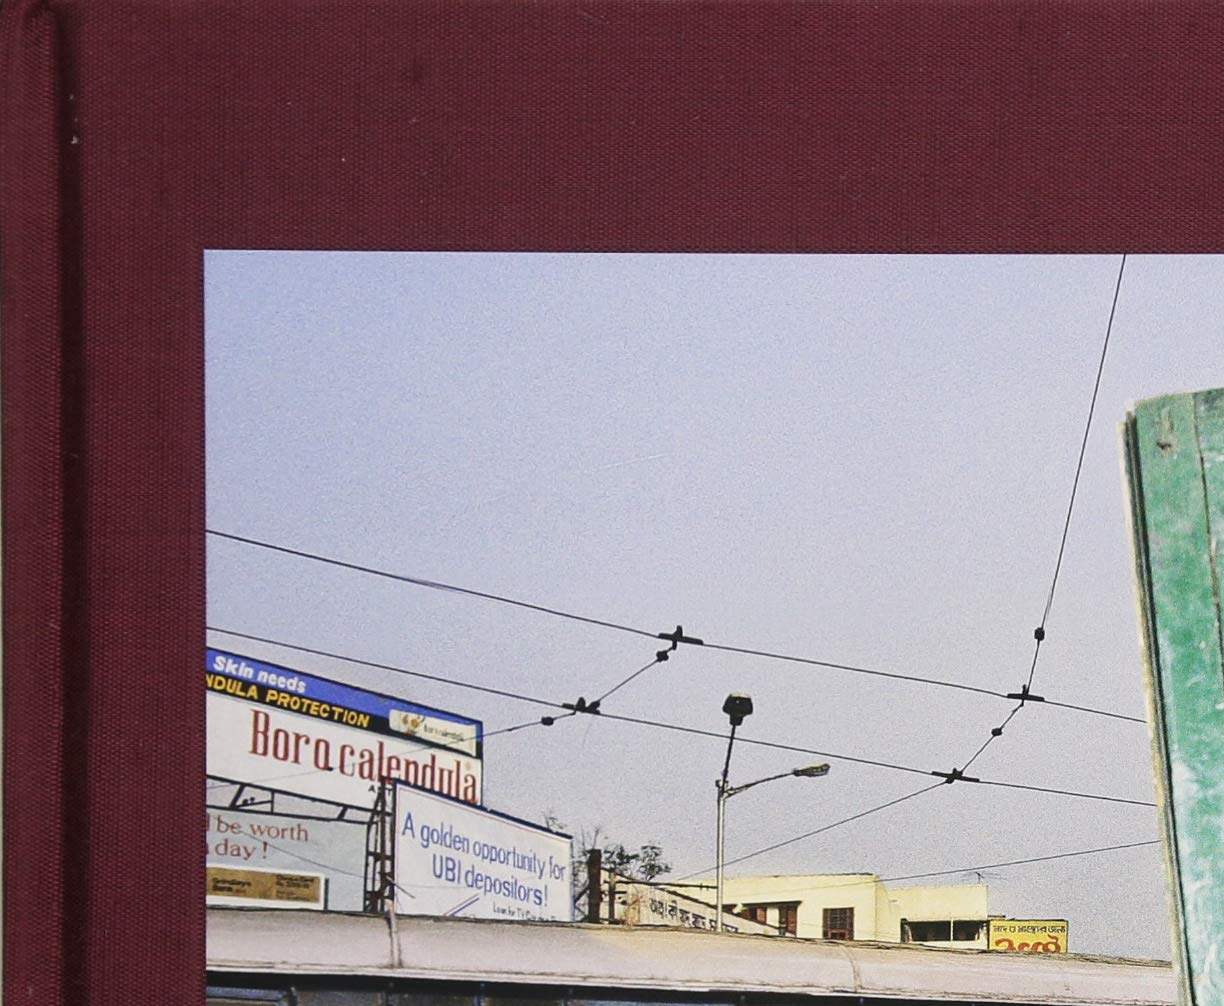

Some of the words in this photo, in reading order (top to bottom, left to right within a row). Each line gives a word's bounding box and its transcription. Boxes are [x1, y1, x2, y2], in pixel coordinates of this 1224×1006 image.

[212, 655, 254, 679] Skin
[257, 669, 307, 694] needs
[265, 689, 371, 728] PROTECTION
[216, 814, 242, 835] be
[250, 822, 309, 842] worth
[402, 812, 415, 838] A
[420, 821, 470, 854] golden
[472, 840, 546, 879] opportunity
[549, 855, 567, 881] for
[432, 853, 462, 884] UBI
[464, 864, 549, 908] depositors!
